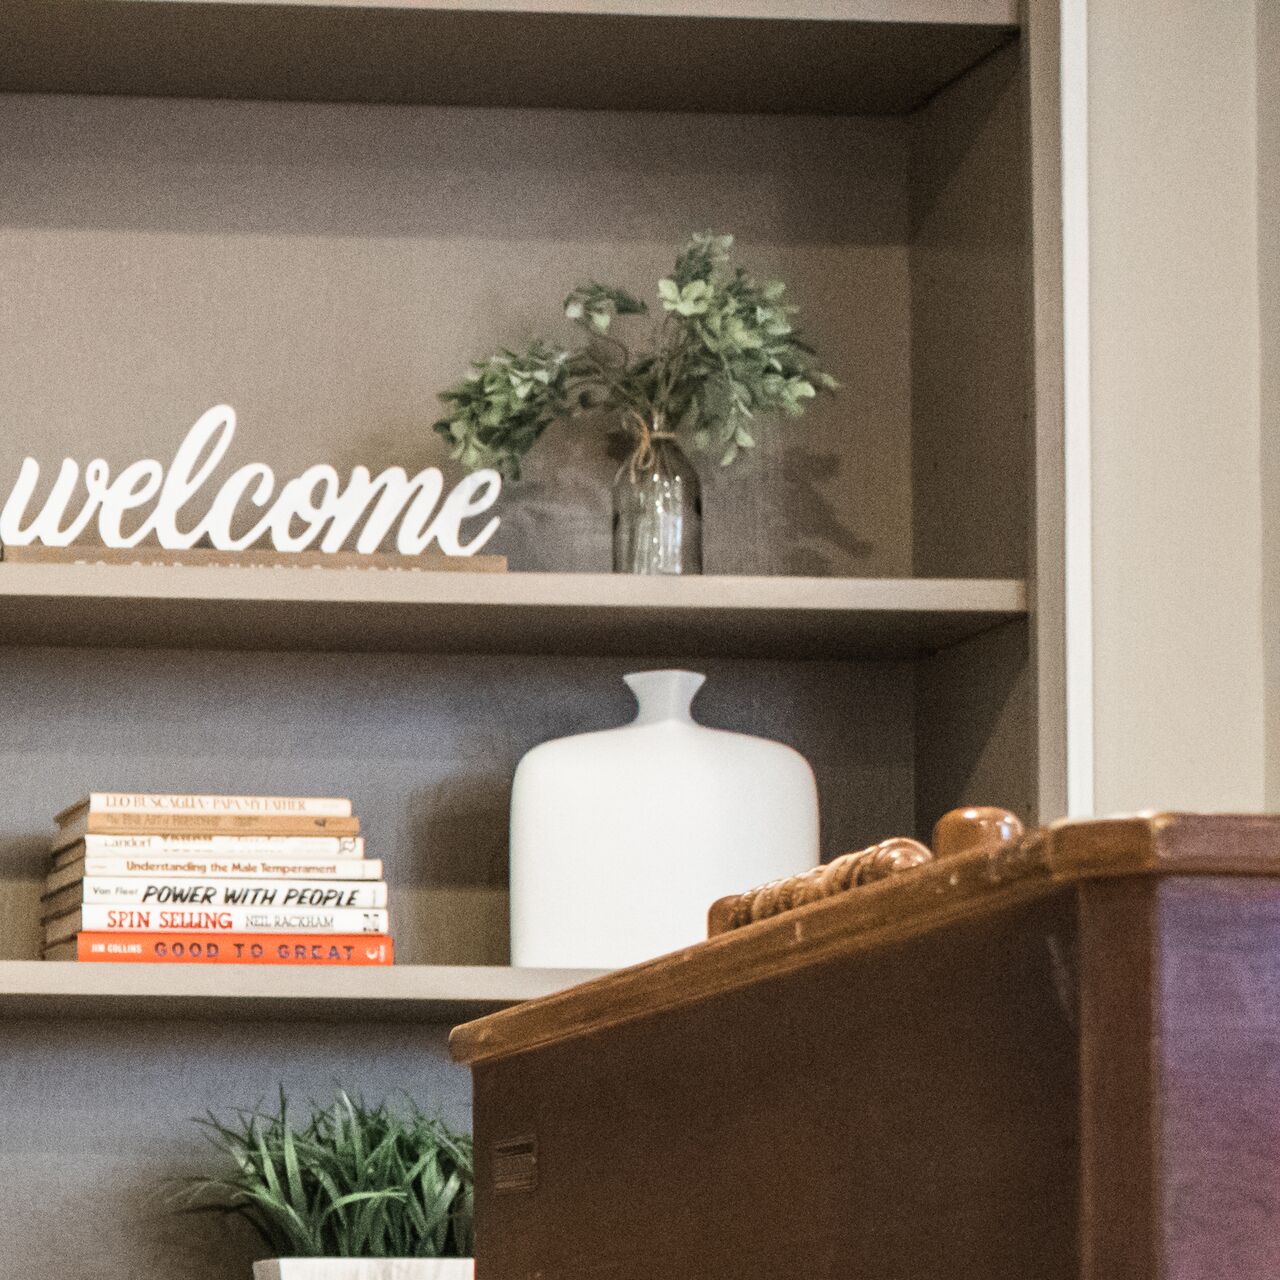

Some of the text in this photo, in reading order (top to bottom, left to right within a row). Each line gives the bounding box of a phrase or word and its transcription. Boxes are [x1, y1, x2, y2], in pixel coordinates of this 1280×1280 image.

[0, 404, 502, 557] welcome
[105, 794, 130, 808] LEO
[126, 861, 337, 875] Understanding the Male Temperament
[93, 887, 111, 895] Van
[142, 885, 218, 904] POWER
[224, 887, 278, 905] WITH
[283, 888, 359, 907] PEOPLE
[107, 910, 334, 929] SPIN SELLING NEIL RACKHAM
[91, 942, 355, 960] JIM COLLINS GOOD TO GREAT
